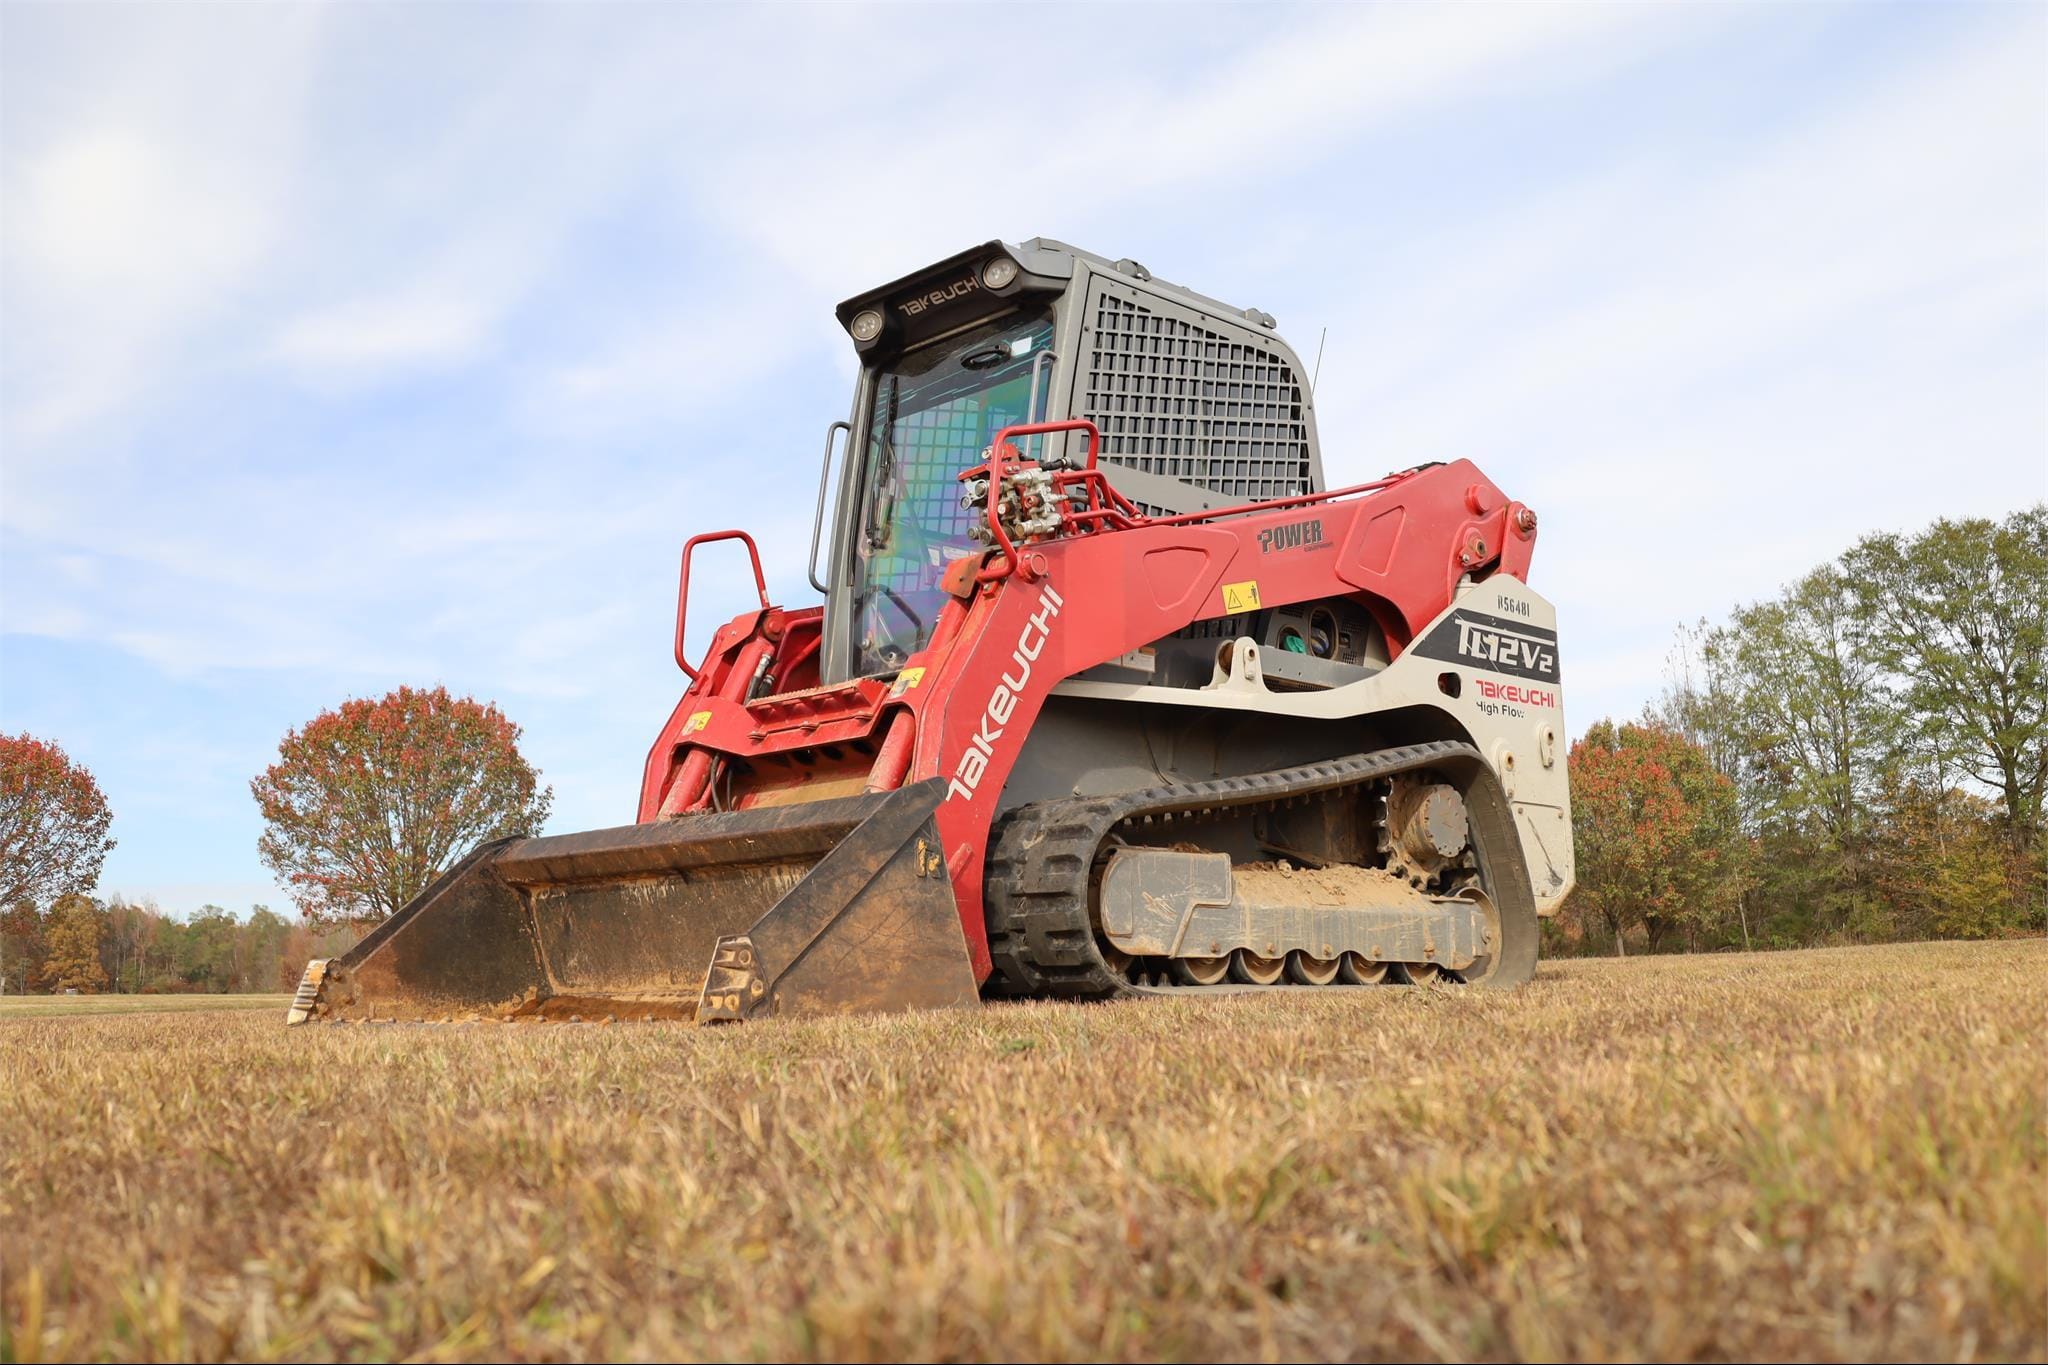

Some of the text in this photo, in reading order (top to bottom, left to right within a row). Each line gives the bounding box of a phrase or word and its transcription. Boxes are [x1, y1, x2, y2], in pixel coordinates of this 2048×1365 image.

[1257, 519, 1322, 554] POWER
[945, 584, 1064, 801] TAKEUCHI
[1475, 680, 1554, 708] TAKEUCHI
[1476, 700, 1499, 716] High
